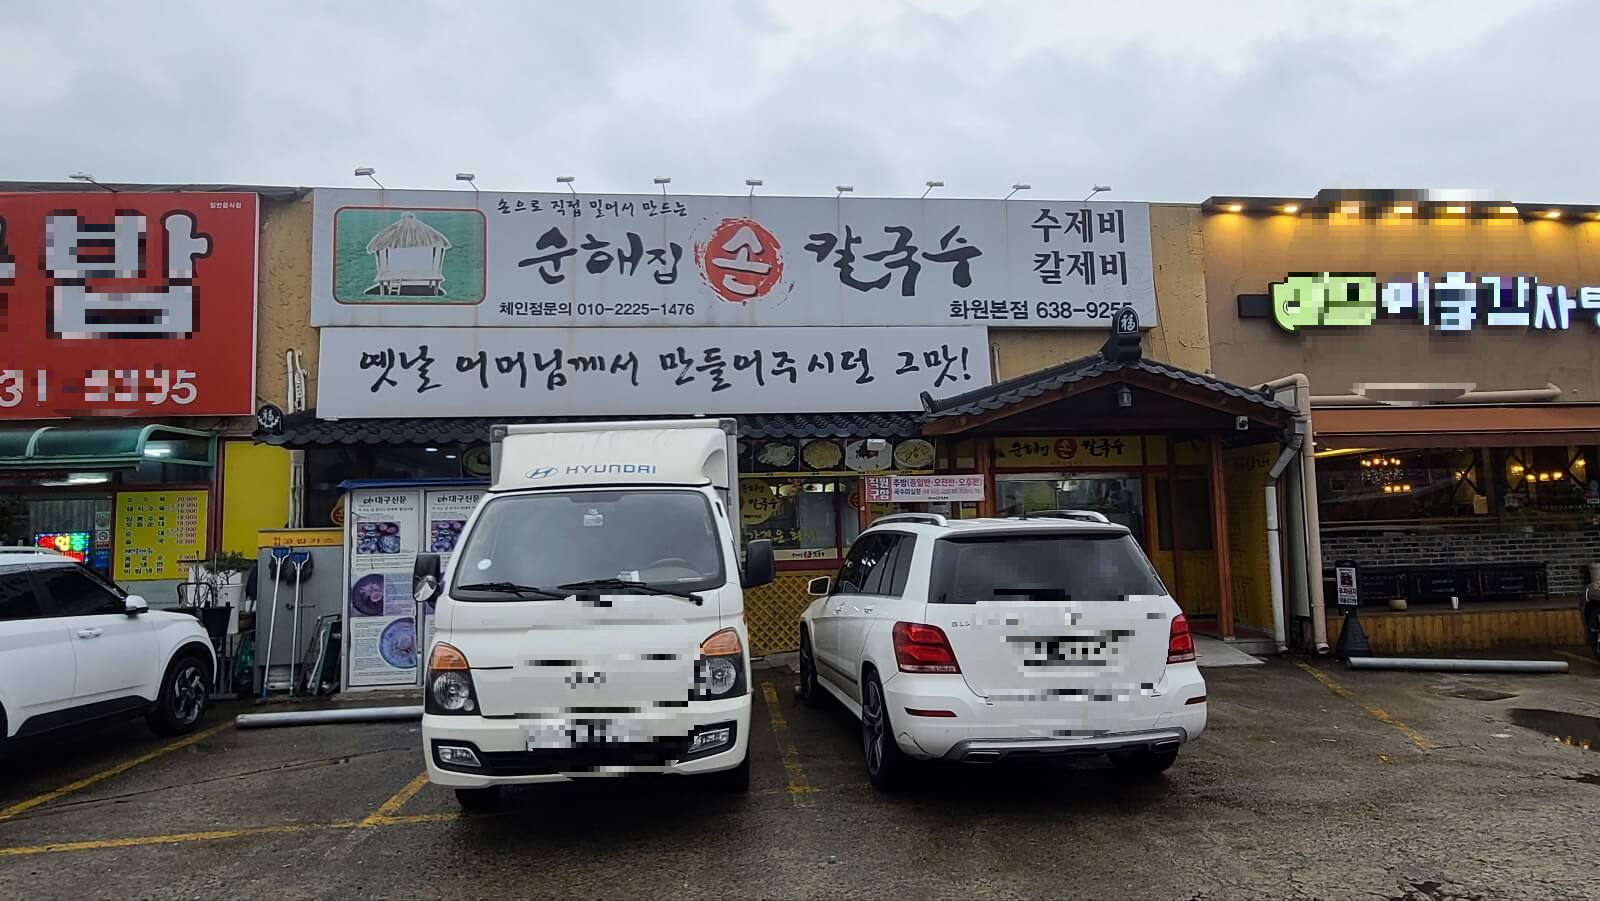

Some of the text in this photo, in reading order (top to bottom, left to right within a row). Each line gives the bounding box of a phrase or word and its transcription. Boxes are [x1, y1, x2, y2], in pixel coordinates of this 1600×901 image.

[498, 198, 688, 218] 손으로 직접 밀어서 만드는
[1031, 208, 1126, 244] 수제비
[519, 225, 983, 297] 순해집 손 칼국수
[1033, 251, 1129, 286] 칼제비
[499, 302, 695, 316] 체인점문의 010-2225-1476
[950, 301, 1028, 319] 화원본점
[1120, 313, 1136, 331] 福
[360, 345, 441, 393] 옛날
[455, 348, 639, 390] 어머님께서
[1081, 438, 1125, 458] 칼국수
[566, 464, 656, 475] HYUNDAI
